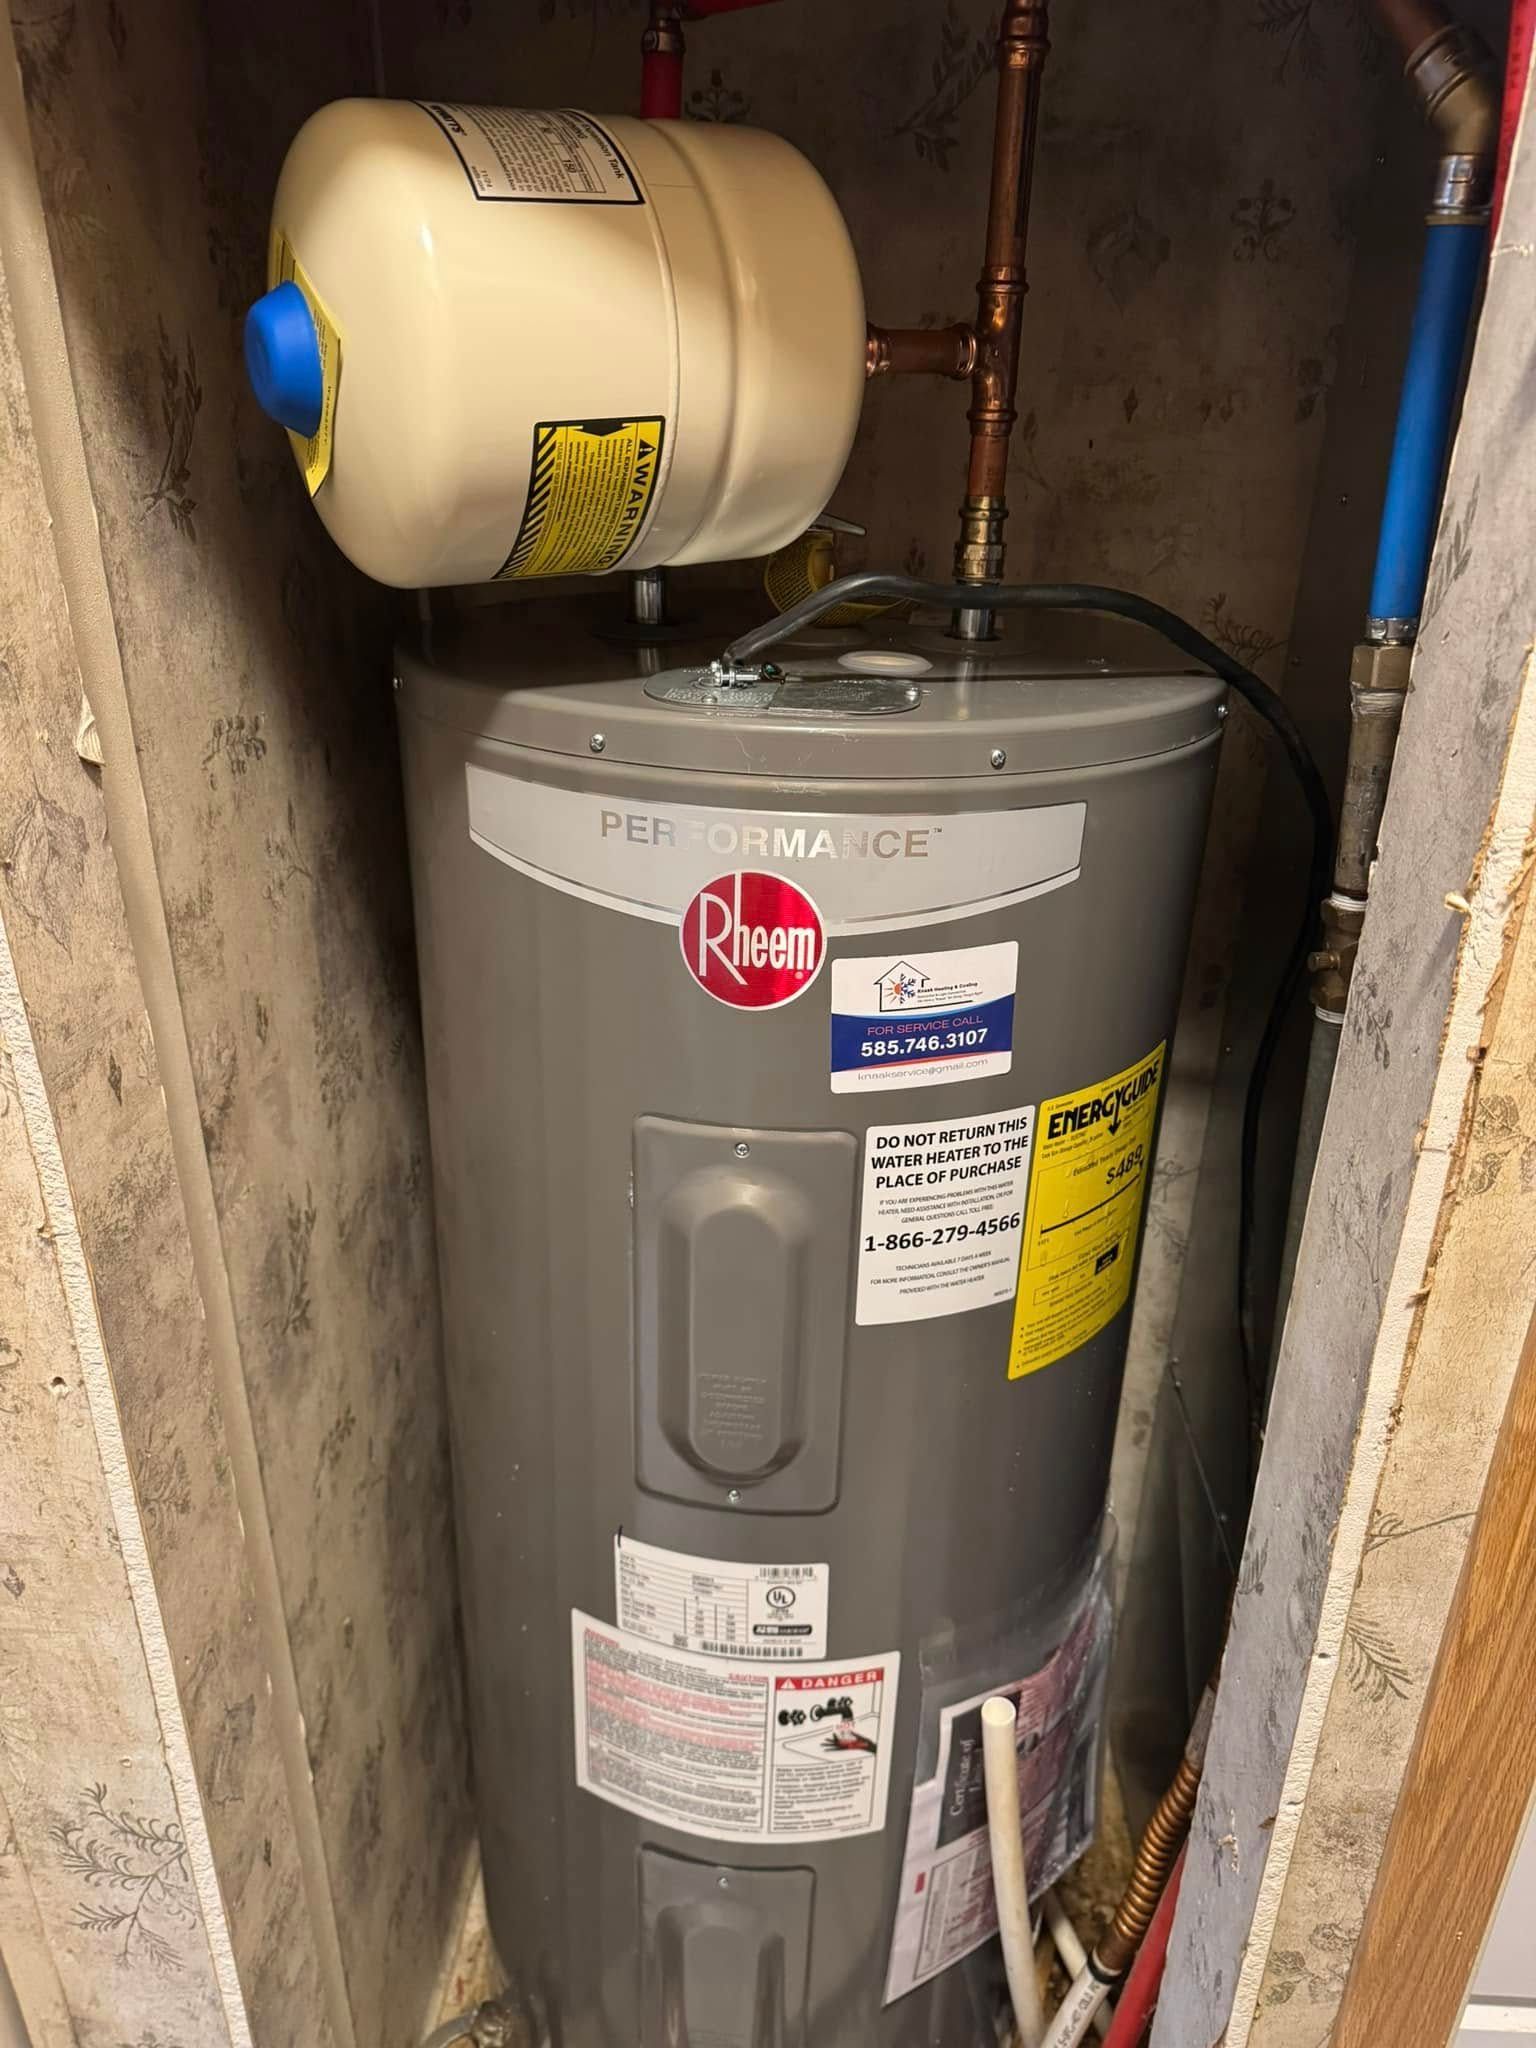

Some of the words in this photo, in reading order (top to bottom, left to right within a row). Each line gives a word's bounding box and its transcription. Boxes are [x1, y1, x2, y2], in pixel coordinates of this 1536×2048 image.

[608, 158, 625, 180] Tank
[598, 462, 651, 568] WARNING
[699, 872, 816, 985] Rheem
[861, 1028, 988, 1057] 585.746.3107
[867, 1025, 894, 1036] FOR
[896, 1019, 950, 1034] SERVICE
[952, 1016, 983, 1028] CALL
[857, 1058, 989, 1081] knaakservice@gmail.com
[1047, 1059, 1160, 1140] ENERGYGUIDE
[876, 1135, 900, 1149] DO
[903, 1132, 937, 1148] NOT
[939, 1123, 996, 1144] RETURN
[998, 1116, 1028, 1134] THIS
[871, 1153, 923, 1170] WATER
[926, 1145, 982, 1165] HEATER
[983, 1141, 1001, 1155] TO
[1003, 1135, 1029, 1152] THE
[876, 1172, 924, 1189] PLACE
[927, 1169, 947, 1184] OF
[949, 1156, 1023, 1182] PURCHASE
[864, 1212, 1020, 1252] 1-866-279-4566
[801, 1671, 878, 1689] DANGER
